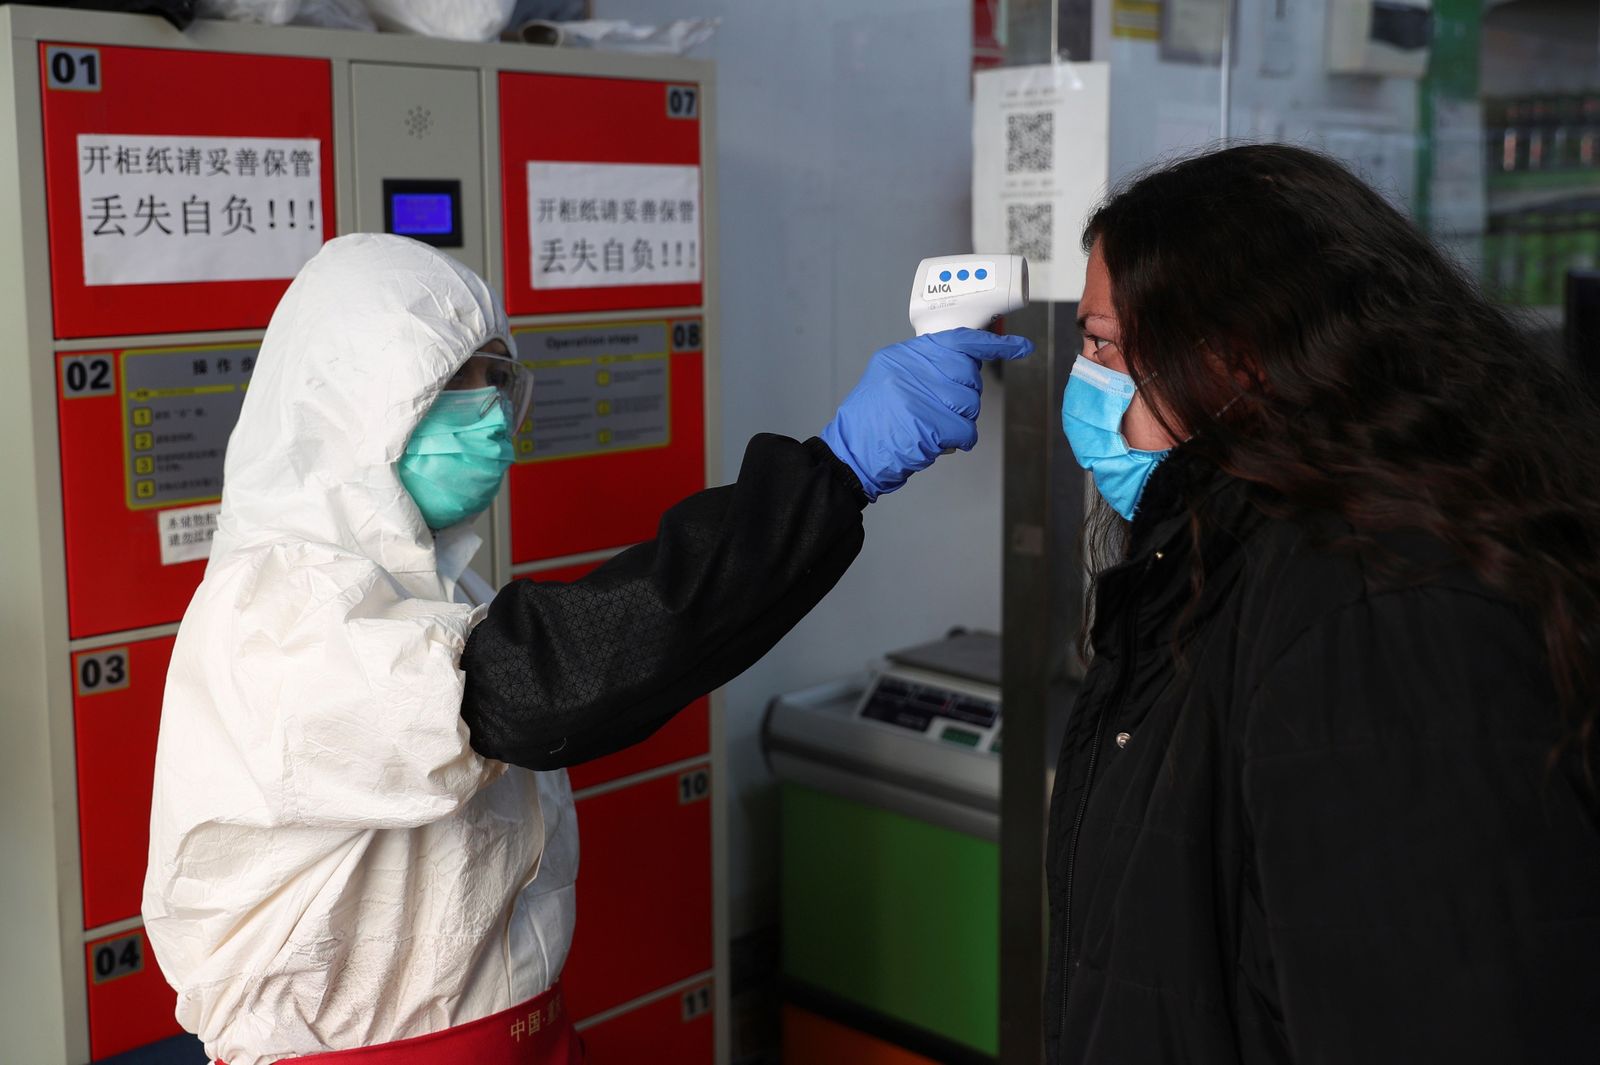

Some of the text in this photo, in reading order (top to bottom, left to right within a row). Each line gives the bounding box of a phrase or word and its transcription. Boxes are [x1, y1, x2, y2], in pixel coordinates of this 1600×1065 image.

[52, 52, 97, 85] 01
[669, 89, 695, 115] 07
[83, 146, 314, 177] 开柜纸请妥善保管
[537, 198, 694, 223] 开柜纸请妥善保管
[927, 284, 952, 294] LAICA
[546, 333, 638, 349] Operation steps
[673, 324, 700, 348] 08
[67, 360, 111, 391] 02
[81, 654, 126, 688] 03
[681, 771, 708, 798] 10
[94, 940, 140, 977] 04
[685, 988, 709, 1017] 11
